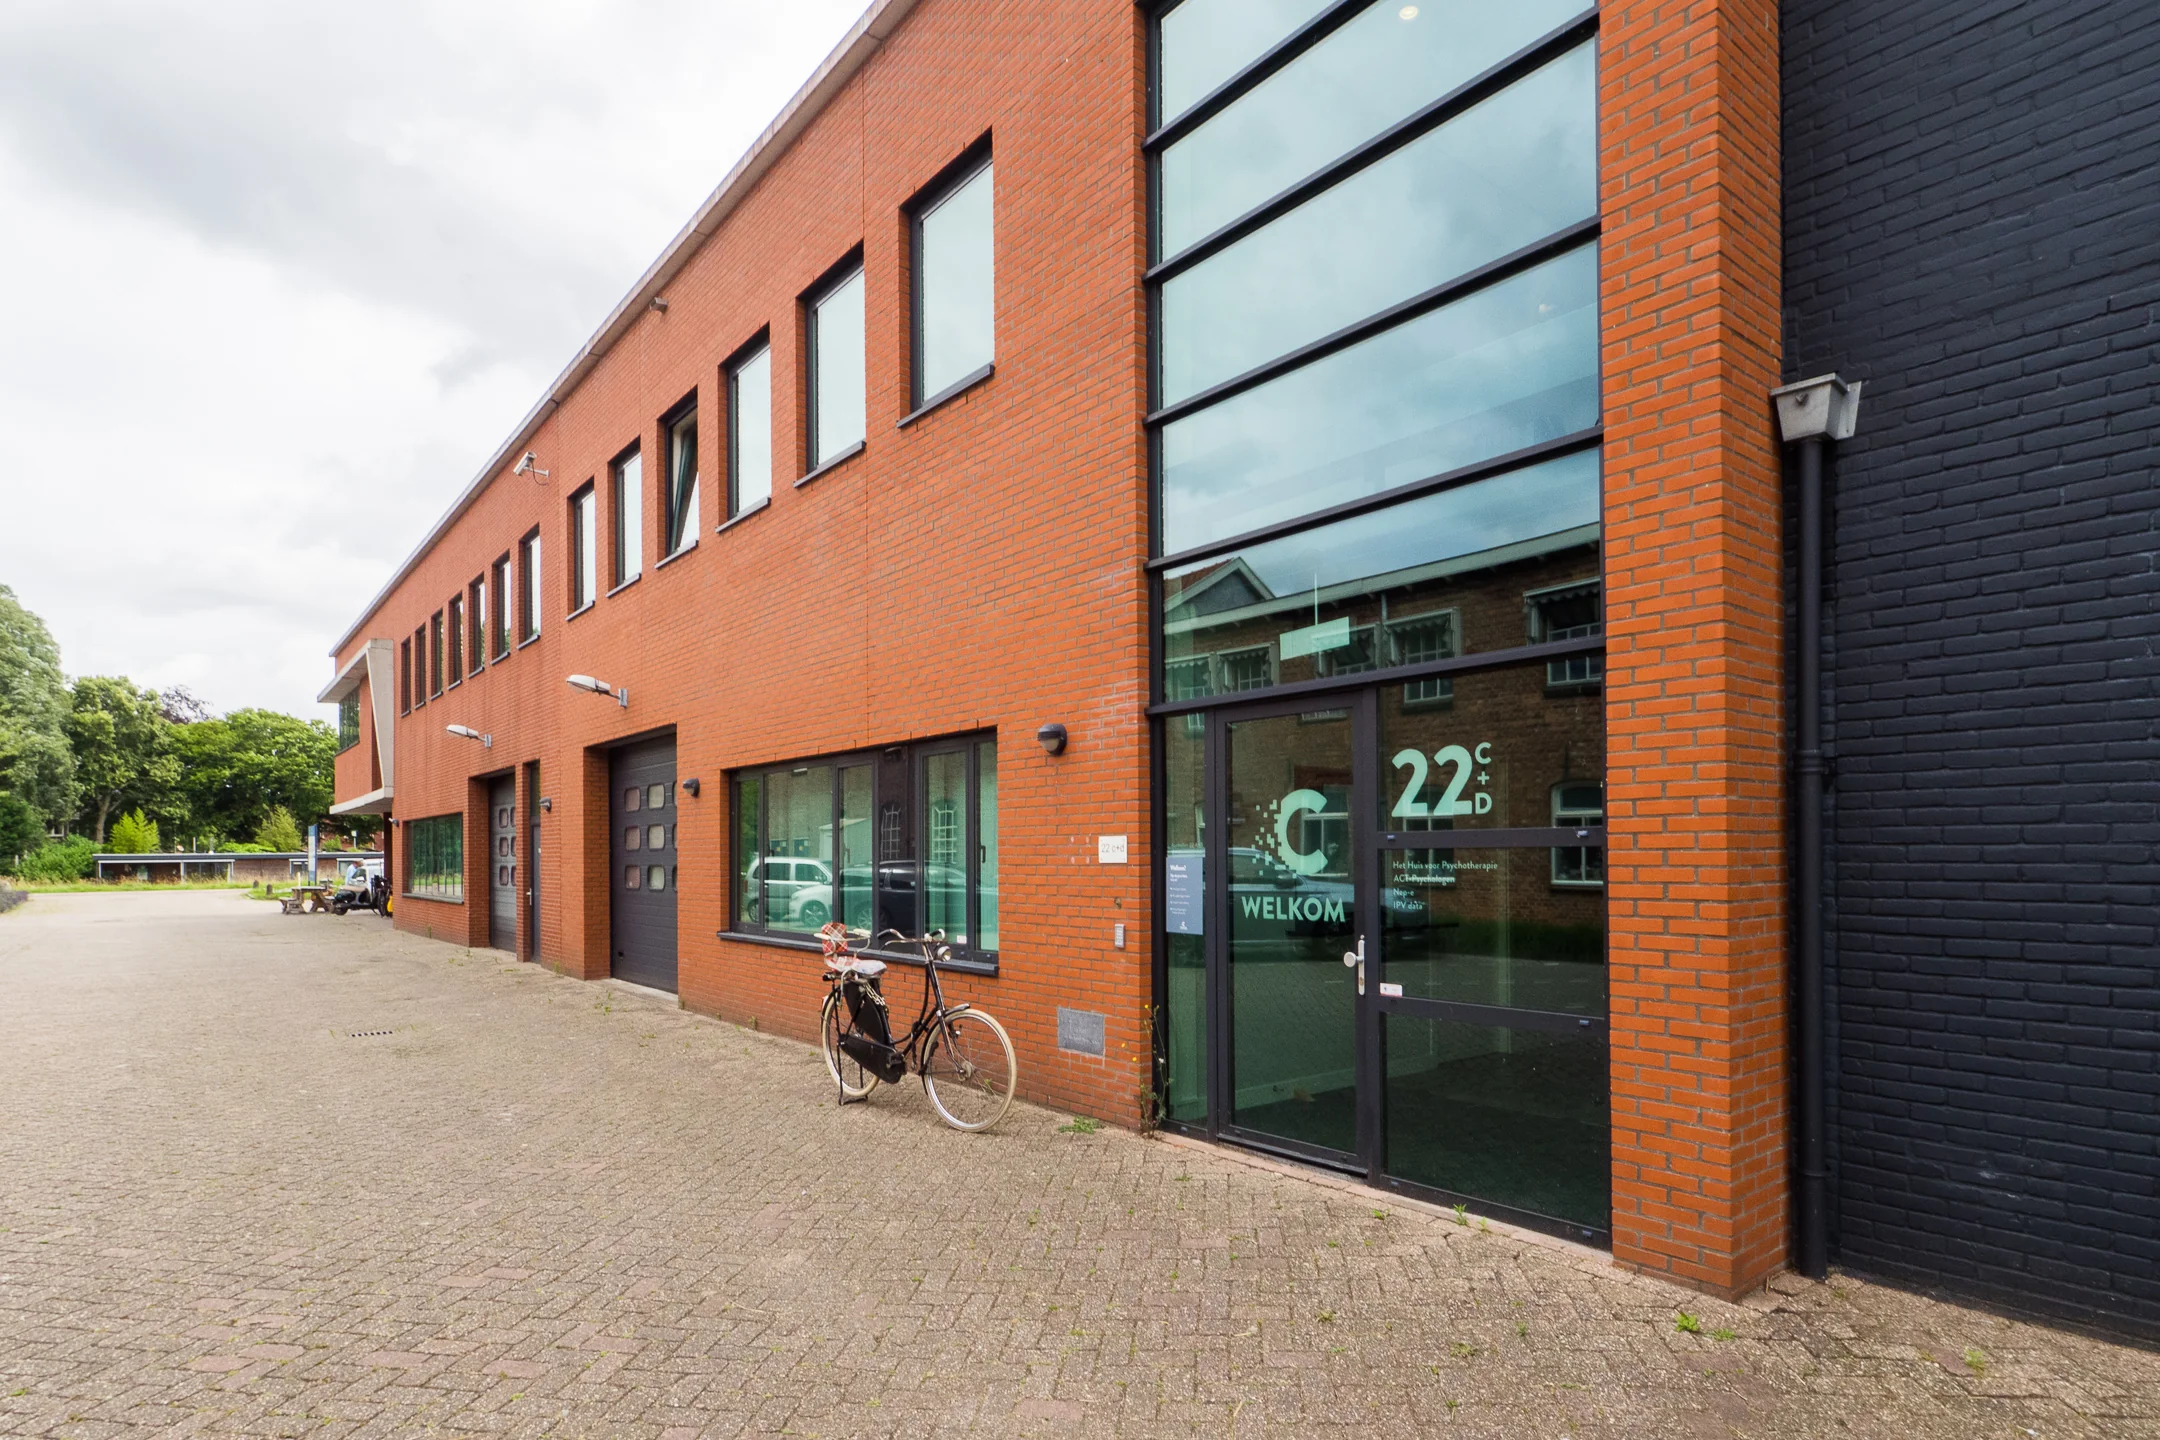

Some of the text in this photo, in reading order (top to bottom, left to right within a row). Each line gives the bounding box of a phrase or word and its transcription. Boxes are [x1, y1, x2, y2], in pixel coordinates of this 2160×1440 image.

[1475, 742, 1492, 765] C
[1391, 744, 1473, 817] 22
[1475, 792, 1492, 815] D
[1101, 843, 1110, 853] 22
[1392, 861, 1406, 869] Het
[1407, 861, 1423, 869] Huis
[1442, 860, 1498, 872] Psychotherapie
[1241, 896, 1345, 922] WELKOM
[1393, 901, 1406, 909] IPV
